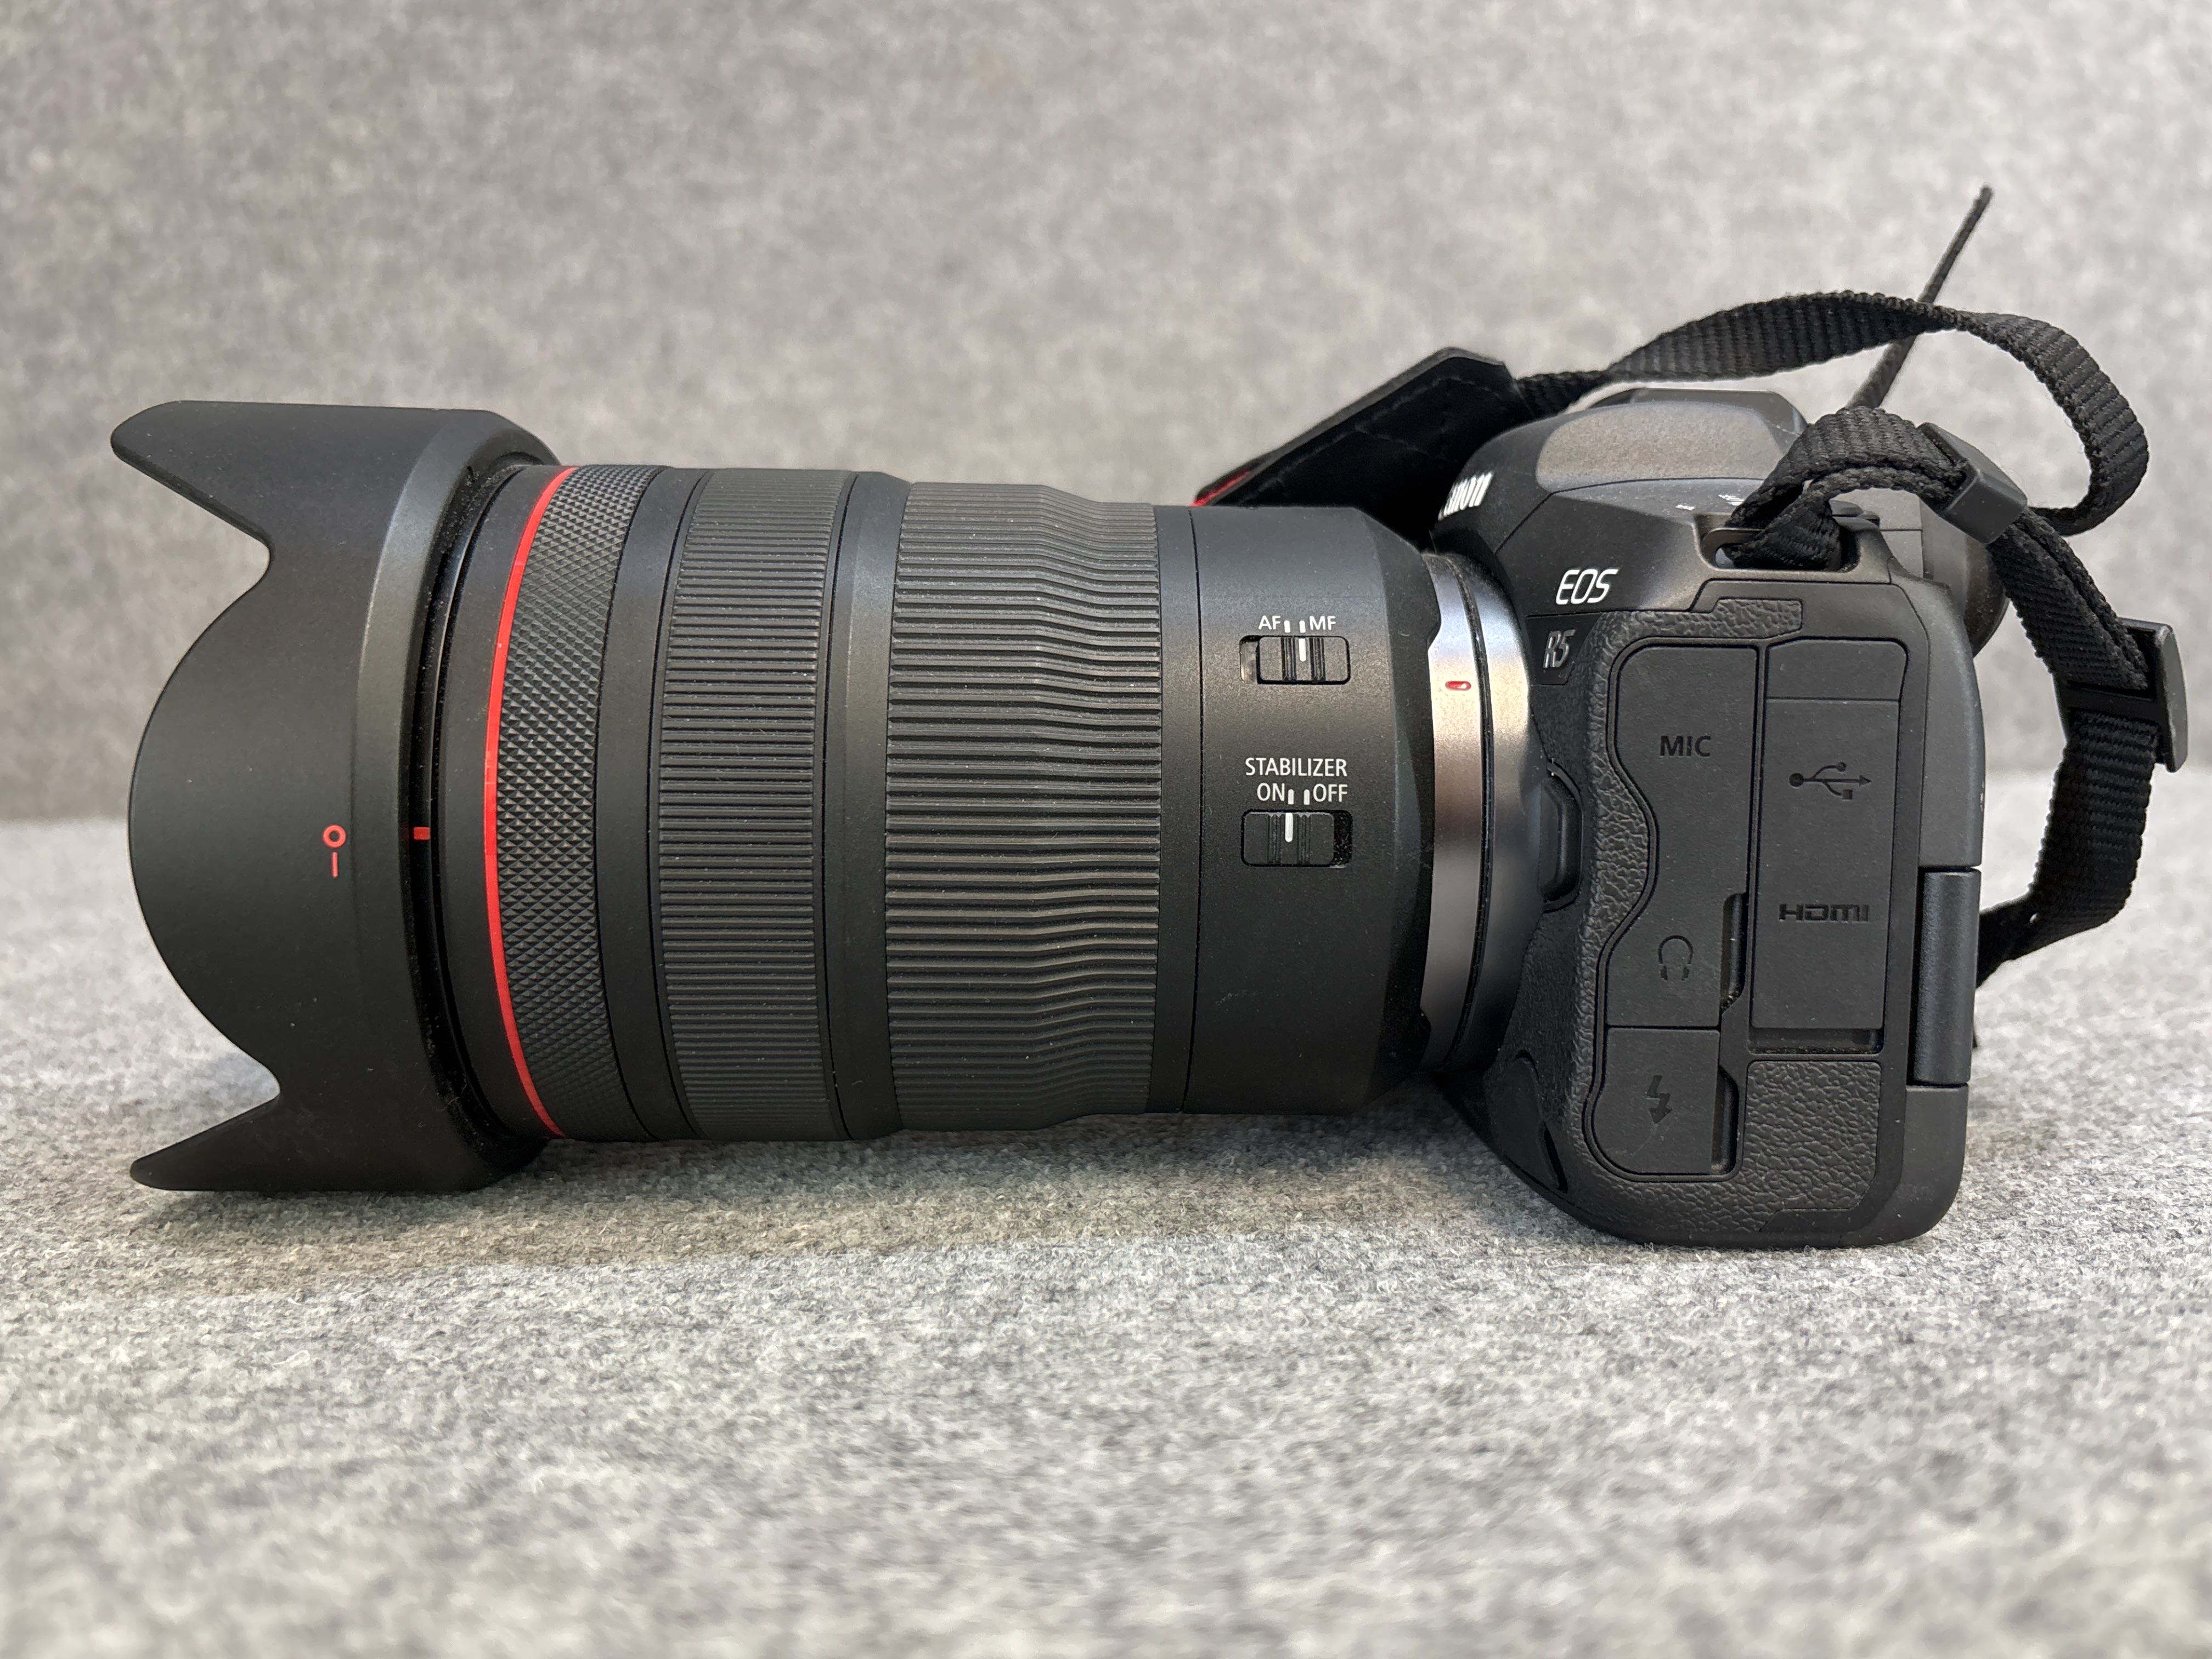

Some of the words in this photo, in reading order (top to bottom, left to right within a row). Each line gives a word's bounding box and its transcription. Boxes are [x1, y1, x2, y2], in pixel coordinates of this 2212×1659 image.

[1437, 471, 1493, 521] anon
[1555, 568, 1619, 605] EOS
[1258, 615, 1281, 630] AF
[1309, 616, 1336, 631] MF
[1543, 629, 1576, 669] R5
[1660, 735, 1712, 757] MIC
[1245, 757, 1348, 777] STABILIZER
[1257, 782, 1285, 802] ON
[1313, 783, 1348, 802] OFF
[1779, 904, 1870, 922] HDMI
